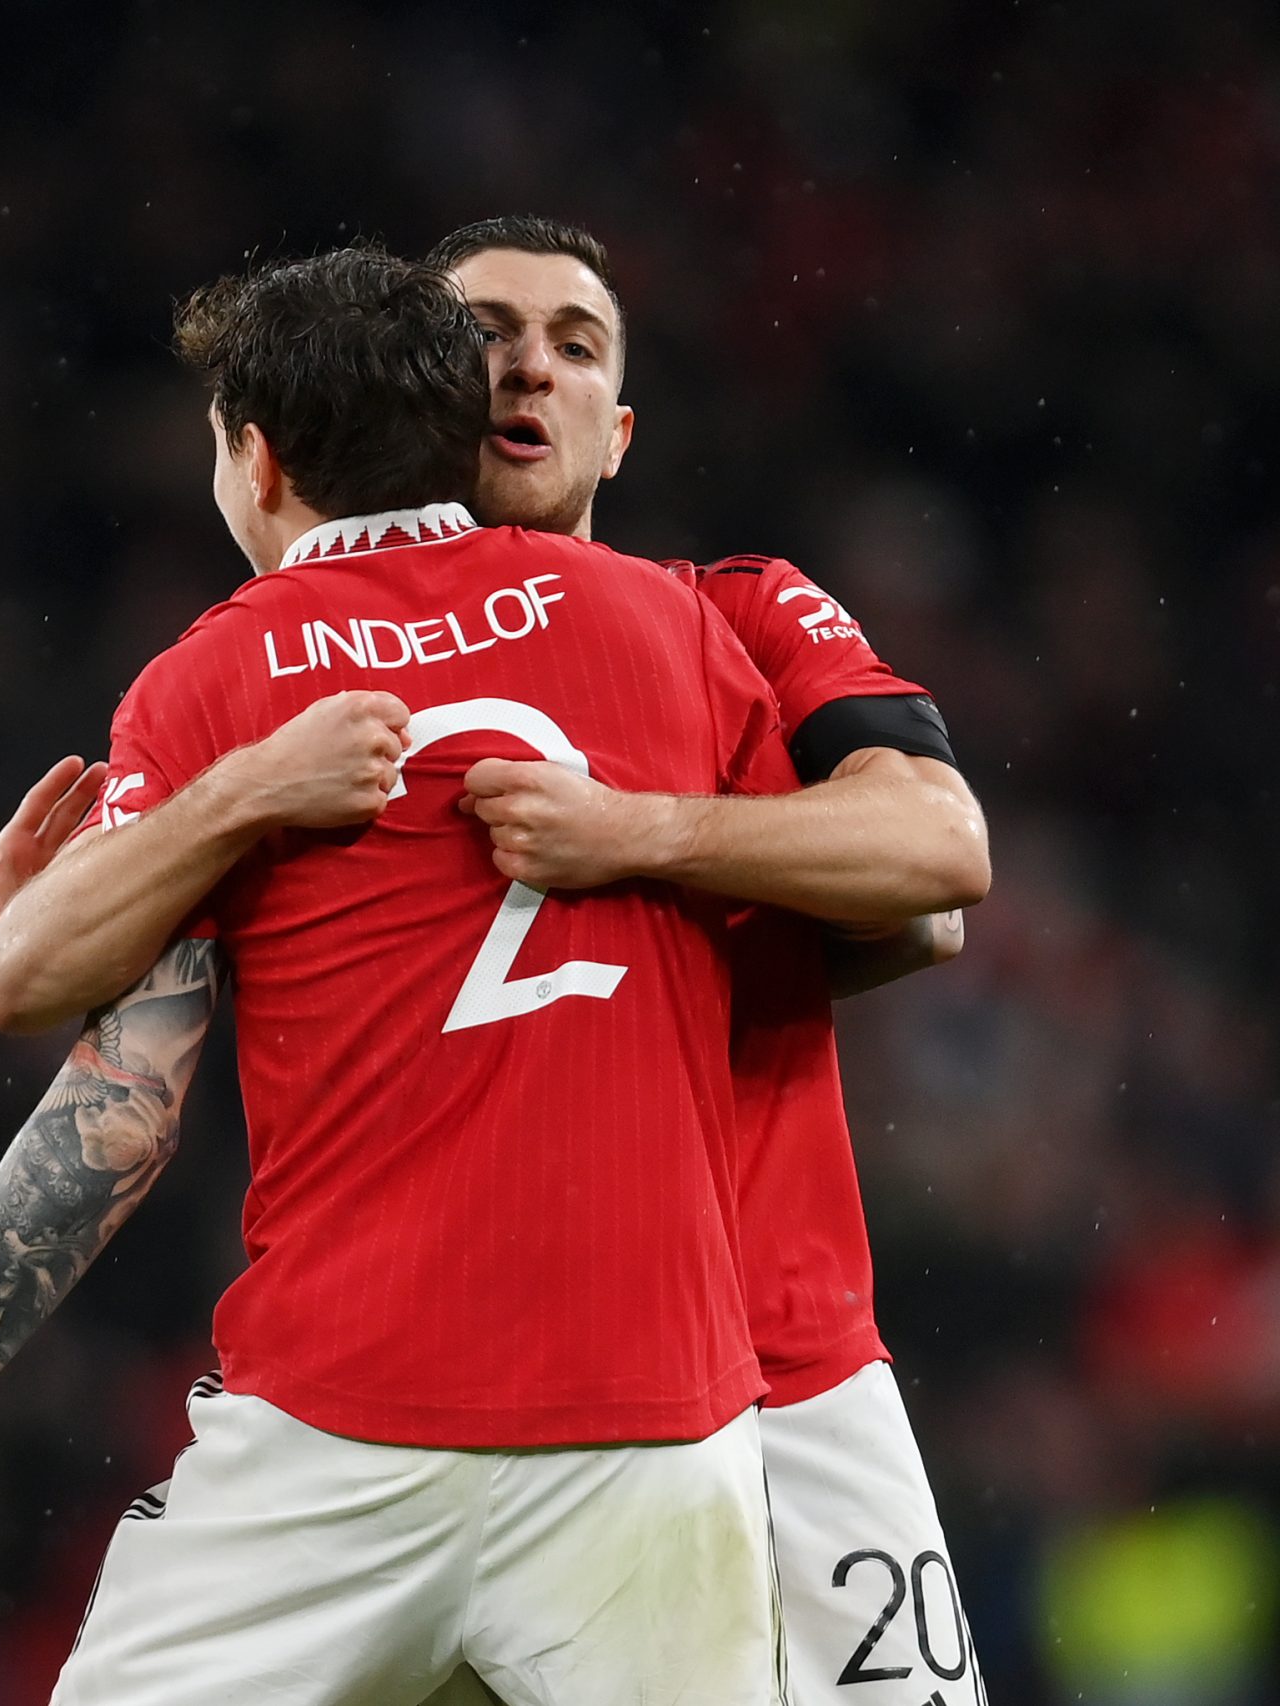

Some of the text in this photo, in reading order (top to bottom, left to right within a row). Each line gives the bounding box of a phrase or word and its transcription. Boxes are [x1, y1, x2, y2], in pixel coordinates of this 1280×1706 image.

[264, 573, 566, 679] LINDELOF
[387, 697, 629, 1034] 2
[831, 1548, 967, 1687] 20
